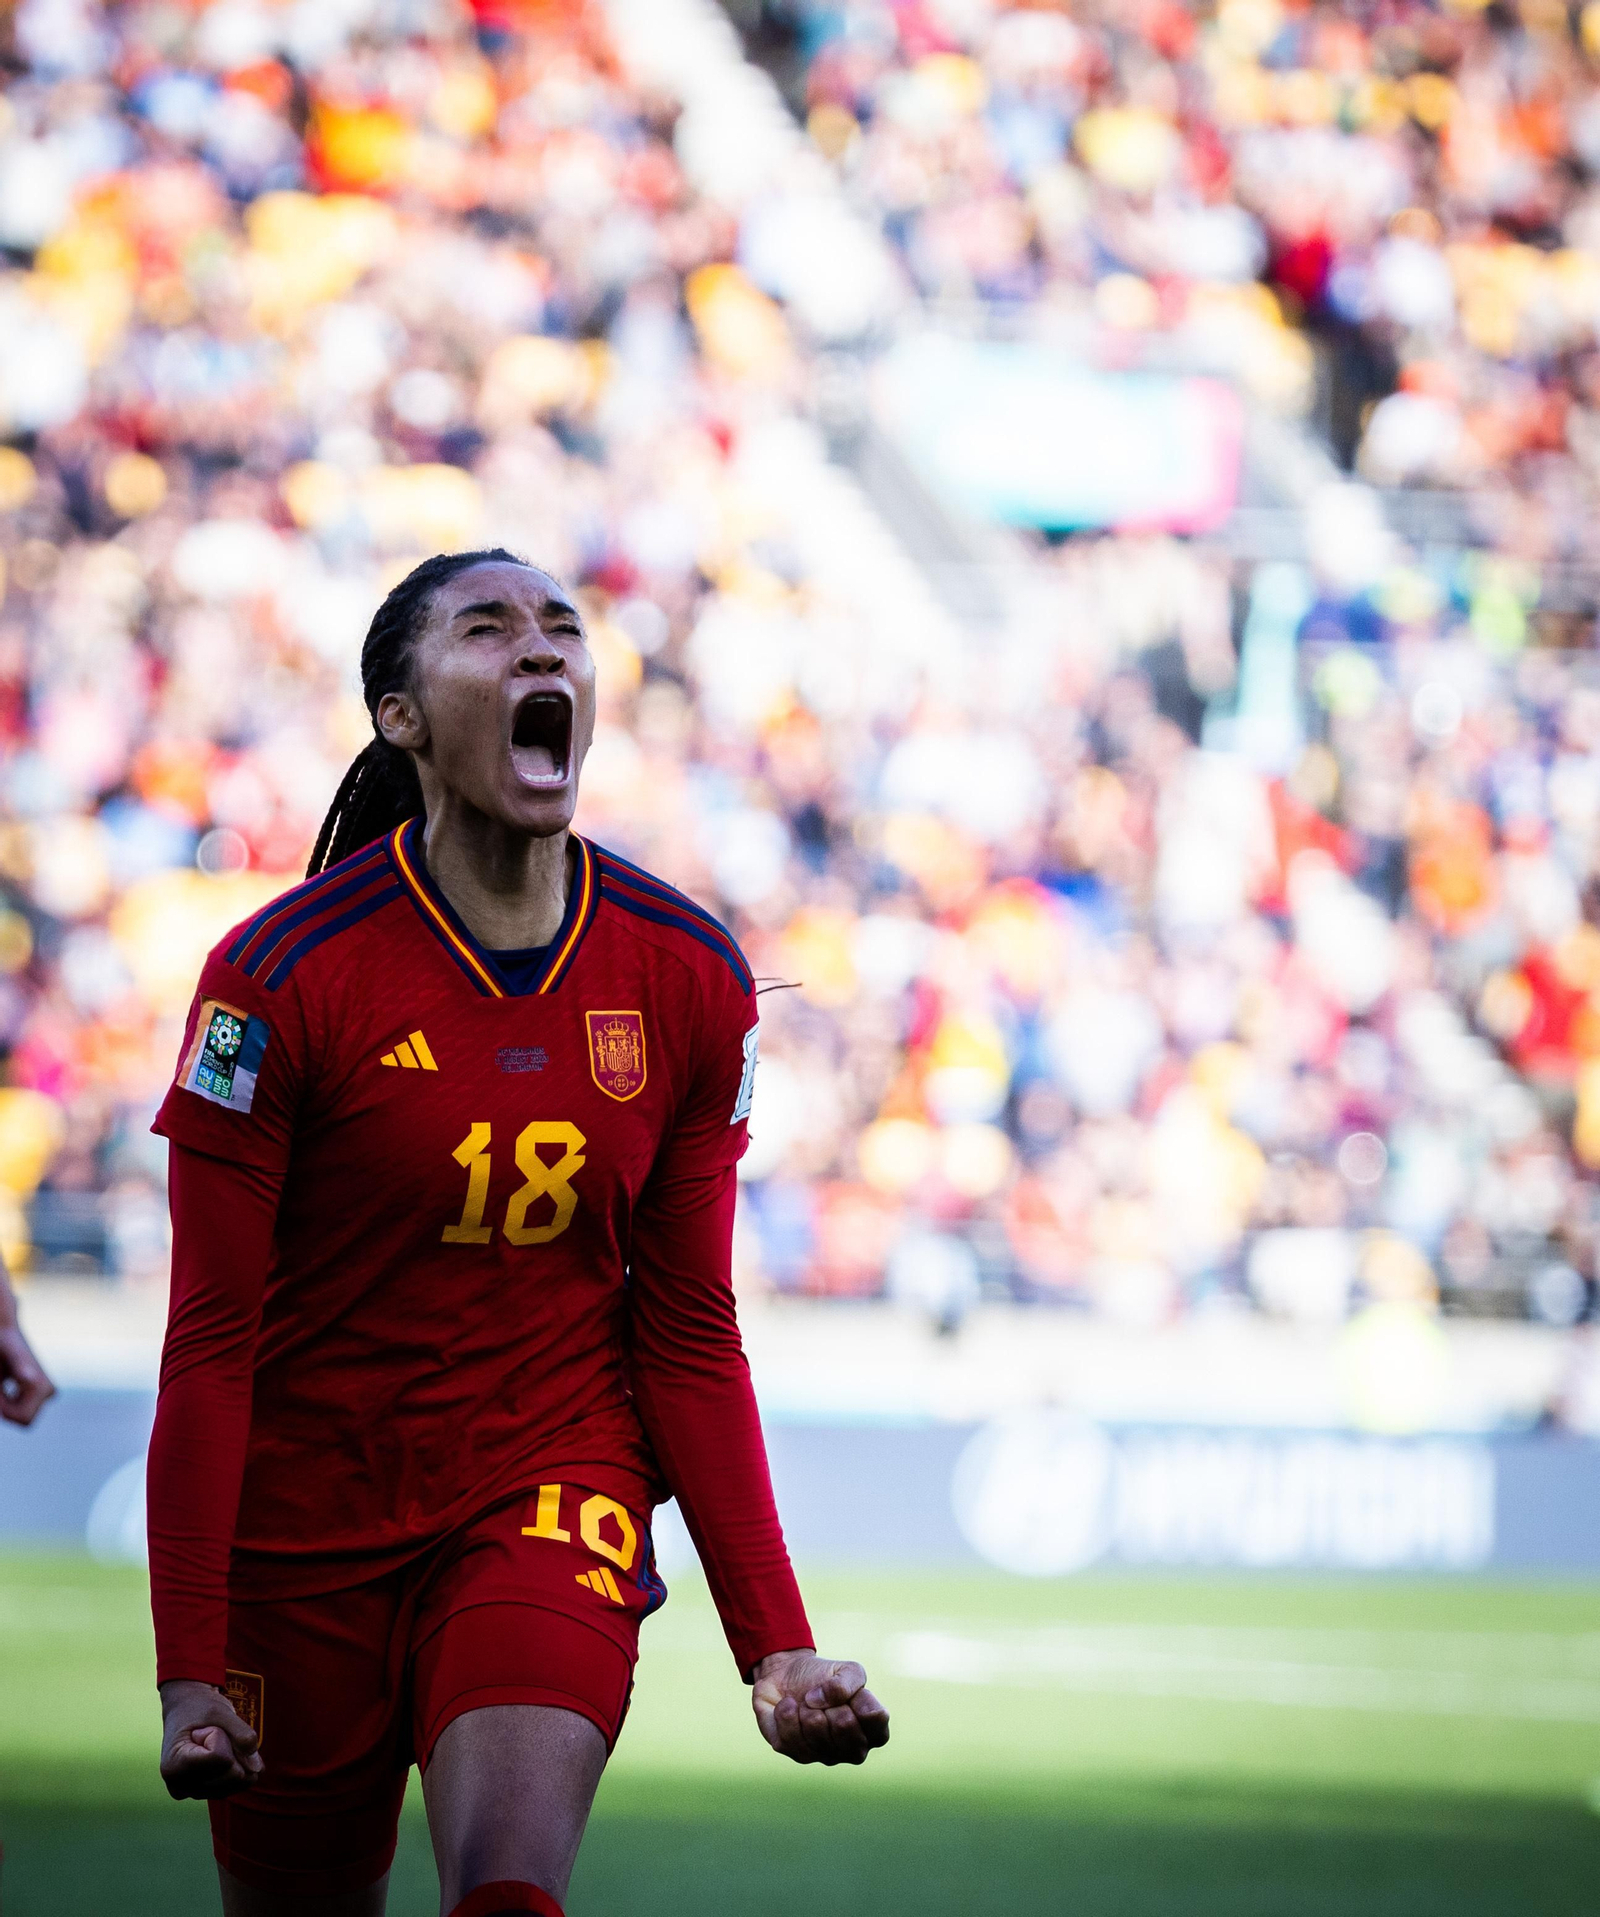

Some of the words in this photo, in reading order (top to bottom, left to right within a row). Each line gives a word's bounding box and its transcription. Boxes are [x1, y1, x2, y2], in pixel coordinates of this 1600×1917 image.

[205, 1049, 215, 1058] FIFA
[200, 1068, 213, 1080] AU
[198, 1076, 211, 1089] NZ
[441, 1121, 587, 1246] 18
